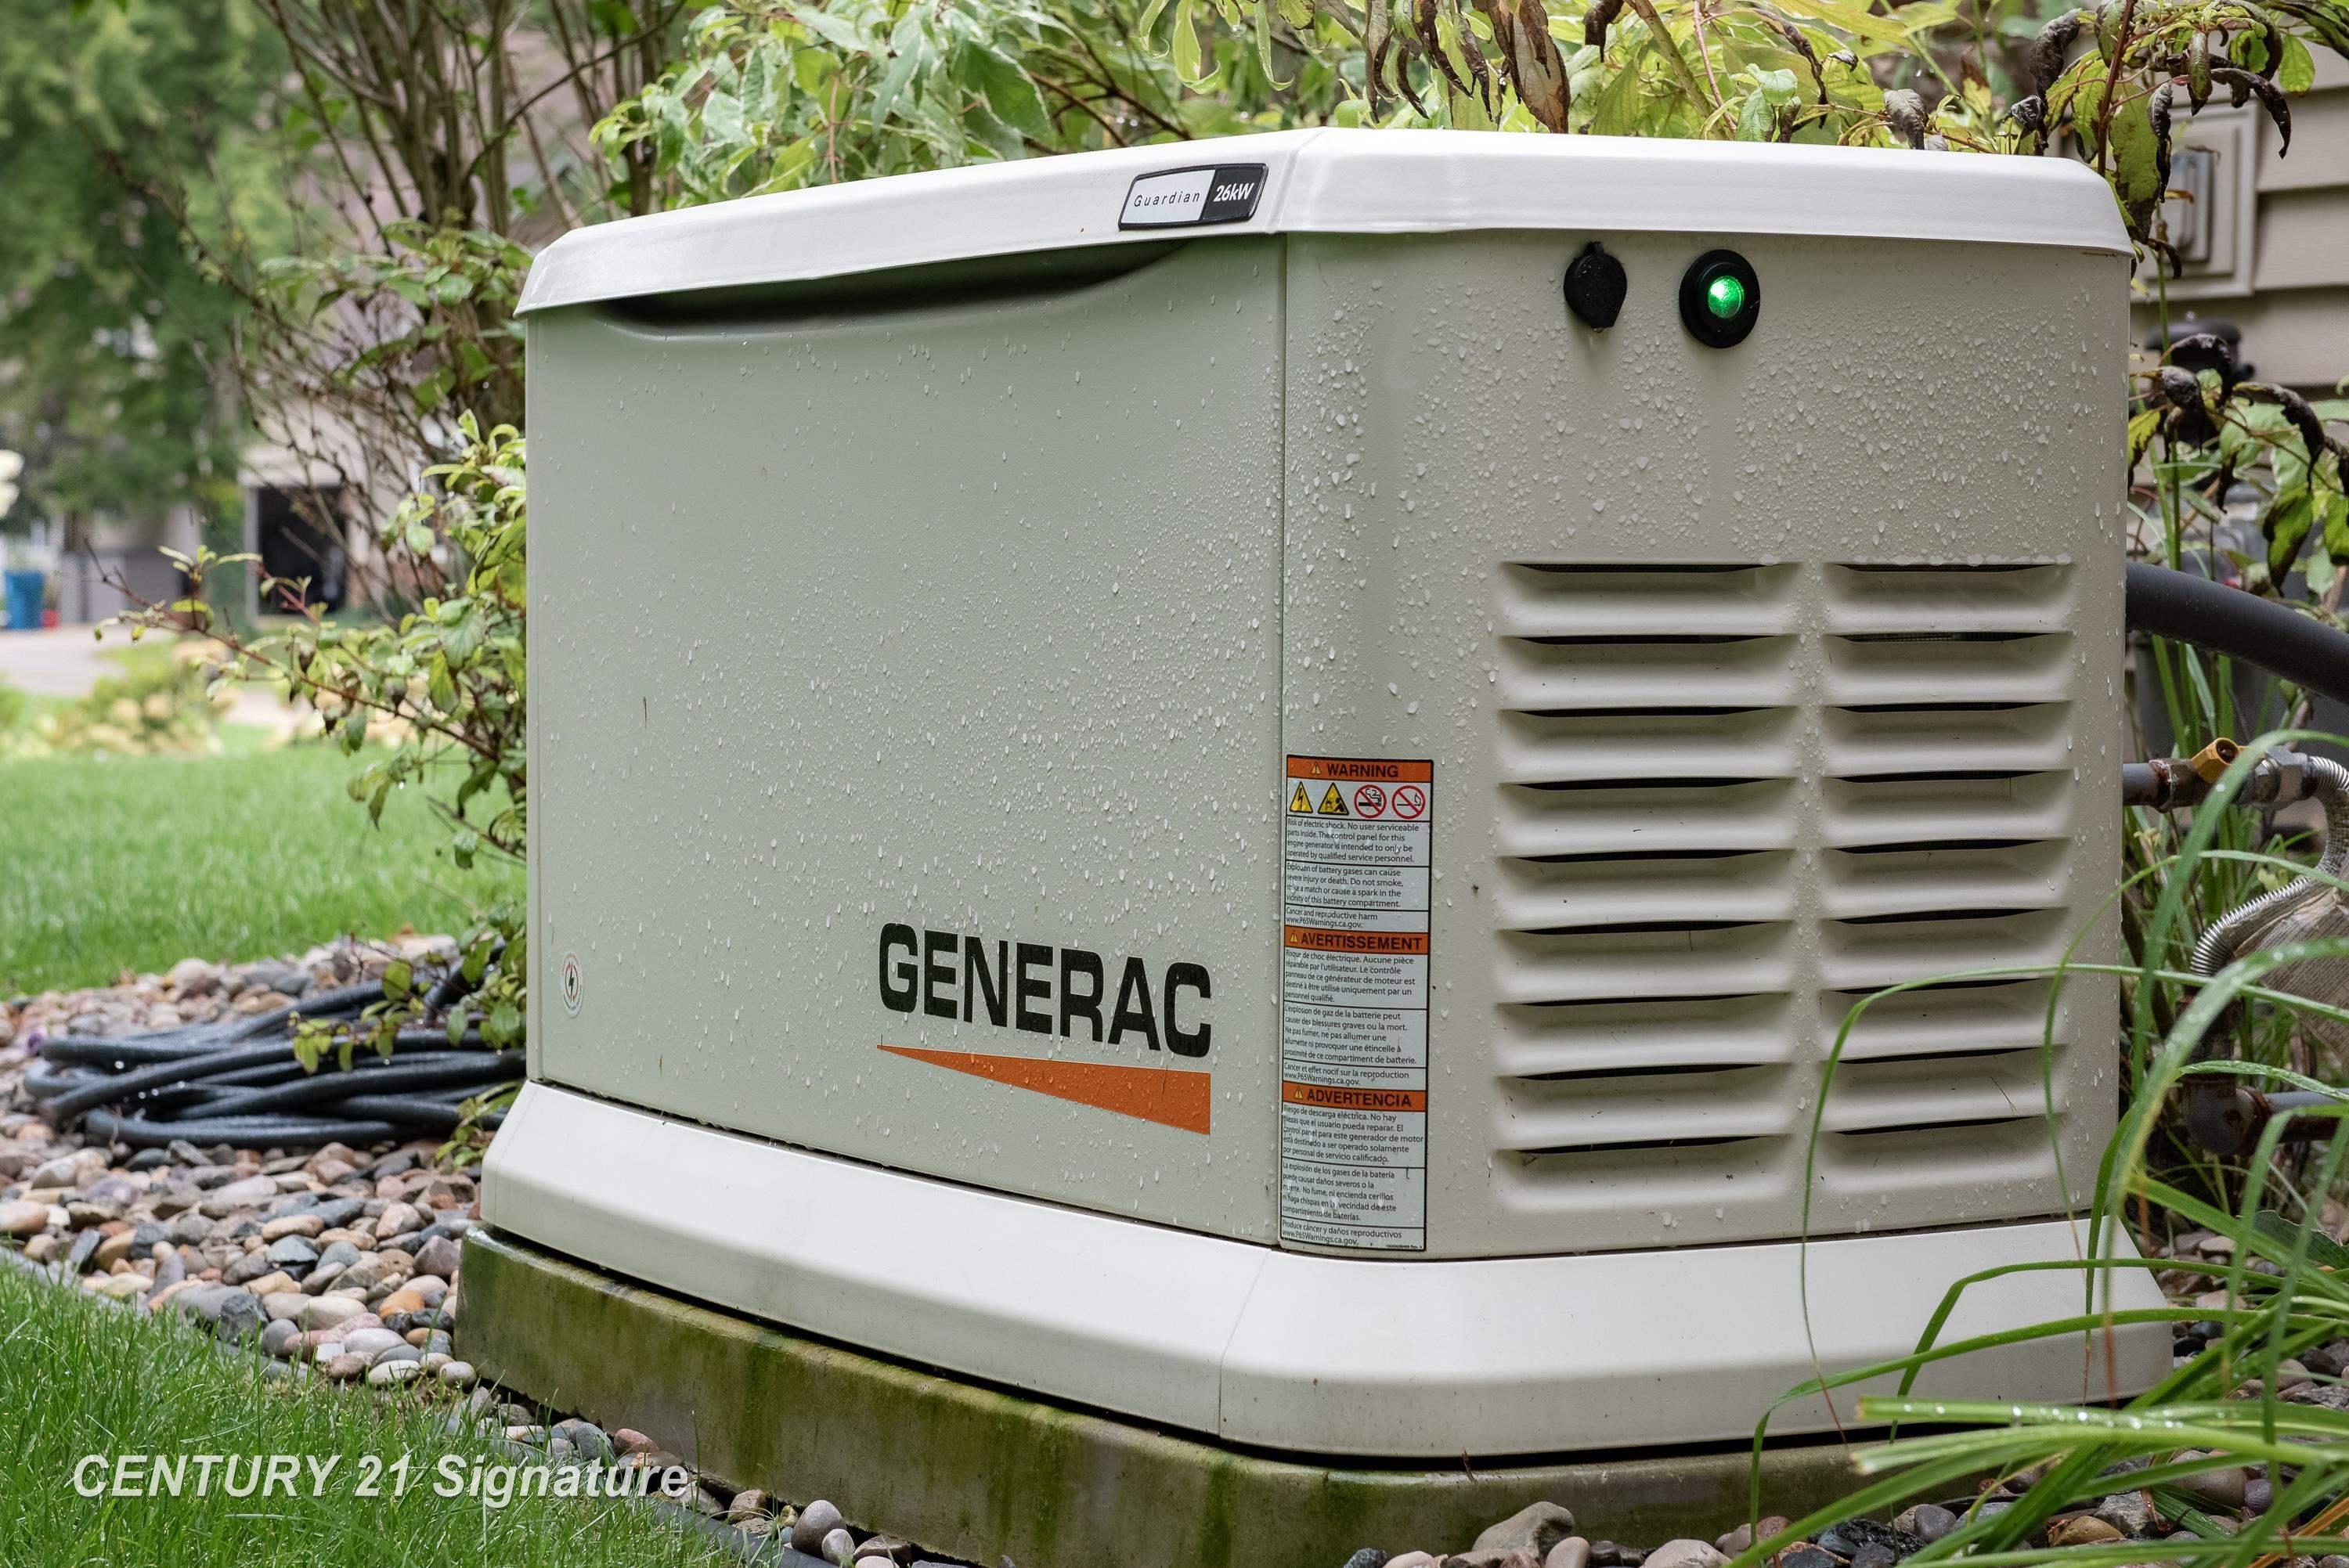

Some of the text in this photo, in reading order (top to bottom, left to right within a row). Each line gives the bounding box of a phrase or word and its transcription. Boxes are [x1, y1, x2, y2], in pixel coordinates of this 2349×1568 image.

[1134, 182, 1254, 207] Guardian 26kW
[1327, 763, 1398, 777] WARNING
[1357, 833, 1377, 842] panel
[1319, 852, 1347, 861] qualified
[1375, 855, 1414, 863] personnel.
[1319, 866, 1341, 875] battery
[1303, 875, 1319, 884] injury
[1328, 877, 1348, 885] death.
[1377, 879, 1403, 888] smoke,
[1358, 889, 1377, 898] spark
[1323, 896, 1346, 906] battery
[1348, 899, 1401, 908] compartment.
[1315, 910, 1356, 920] reproductive
[1301, 932, 1422, 950] AVERTISSEMENT
[1326, 954, 1362, 964] électrique.
[1394, 956, 1414, 965] pièce
[1321, 962, 1358, 972] l'utilisateur.
[1325, 974, 1361, 982] générateur
[879, 922, 1211, 1058] GENERAC
[1341, 986, 1385, 995] uniquement
[1311, 993, 1334, 1002] qualifié.
[1312, 1019, 1340, 1028] blessures
[1302, 1028, 1319, 1037] fumer,
[1331, 1032, 1341, 1040] pas
[1315, 1041, 1348, 1051] provoquer
[1365, 1044, 1395, 1052] étincelle
[1325, 1053, 1372, 1063] compartiment
[1307, 1089, 1412, 1107] ADVERTENCIA
[1308, 1109, 1335, 1119] descarga
[1384, 1114, 1397, 1123] hay
[1349, 1134, 1387, 1143] generador
[1339, 1143, 1368, 1152] operado
[1293, 1148, 1315, 1157] personal
[1326, 1152, 1351, 1160] servicio
[1290, 1162, 1312, 1173] explosión
[1312, 1188, 1327, 1197] fume,
[1301, 1196, 1320, 1206] chispas
[1333, 1210, 1360, 1221] baterías.
[1283, 1220, 1302, 1229] Produce
[1330, 1226, 1348, 1235] daños
[1351, 1229, 1402, 1238] reproductivos
